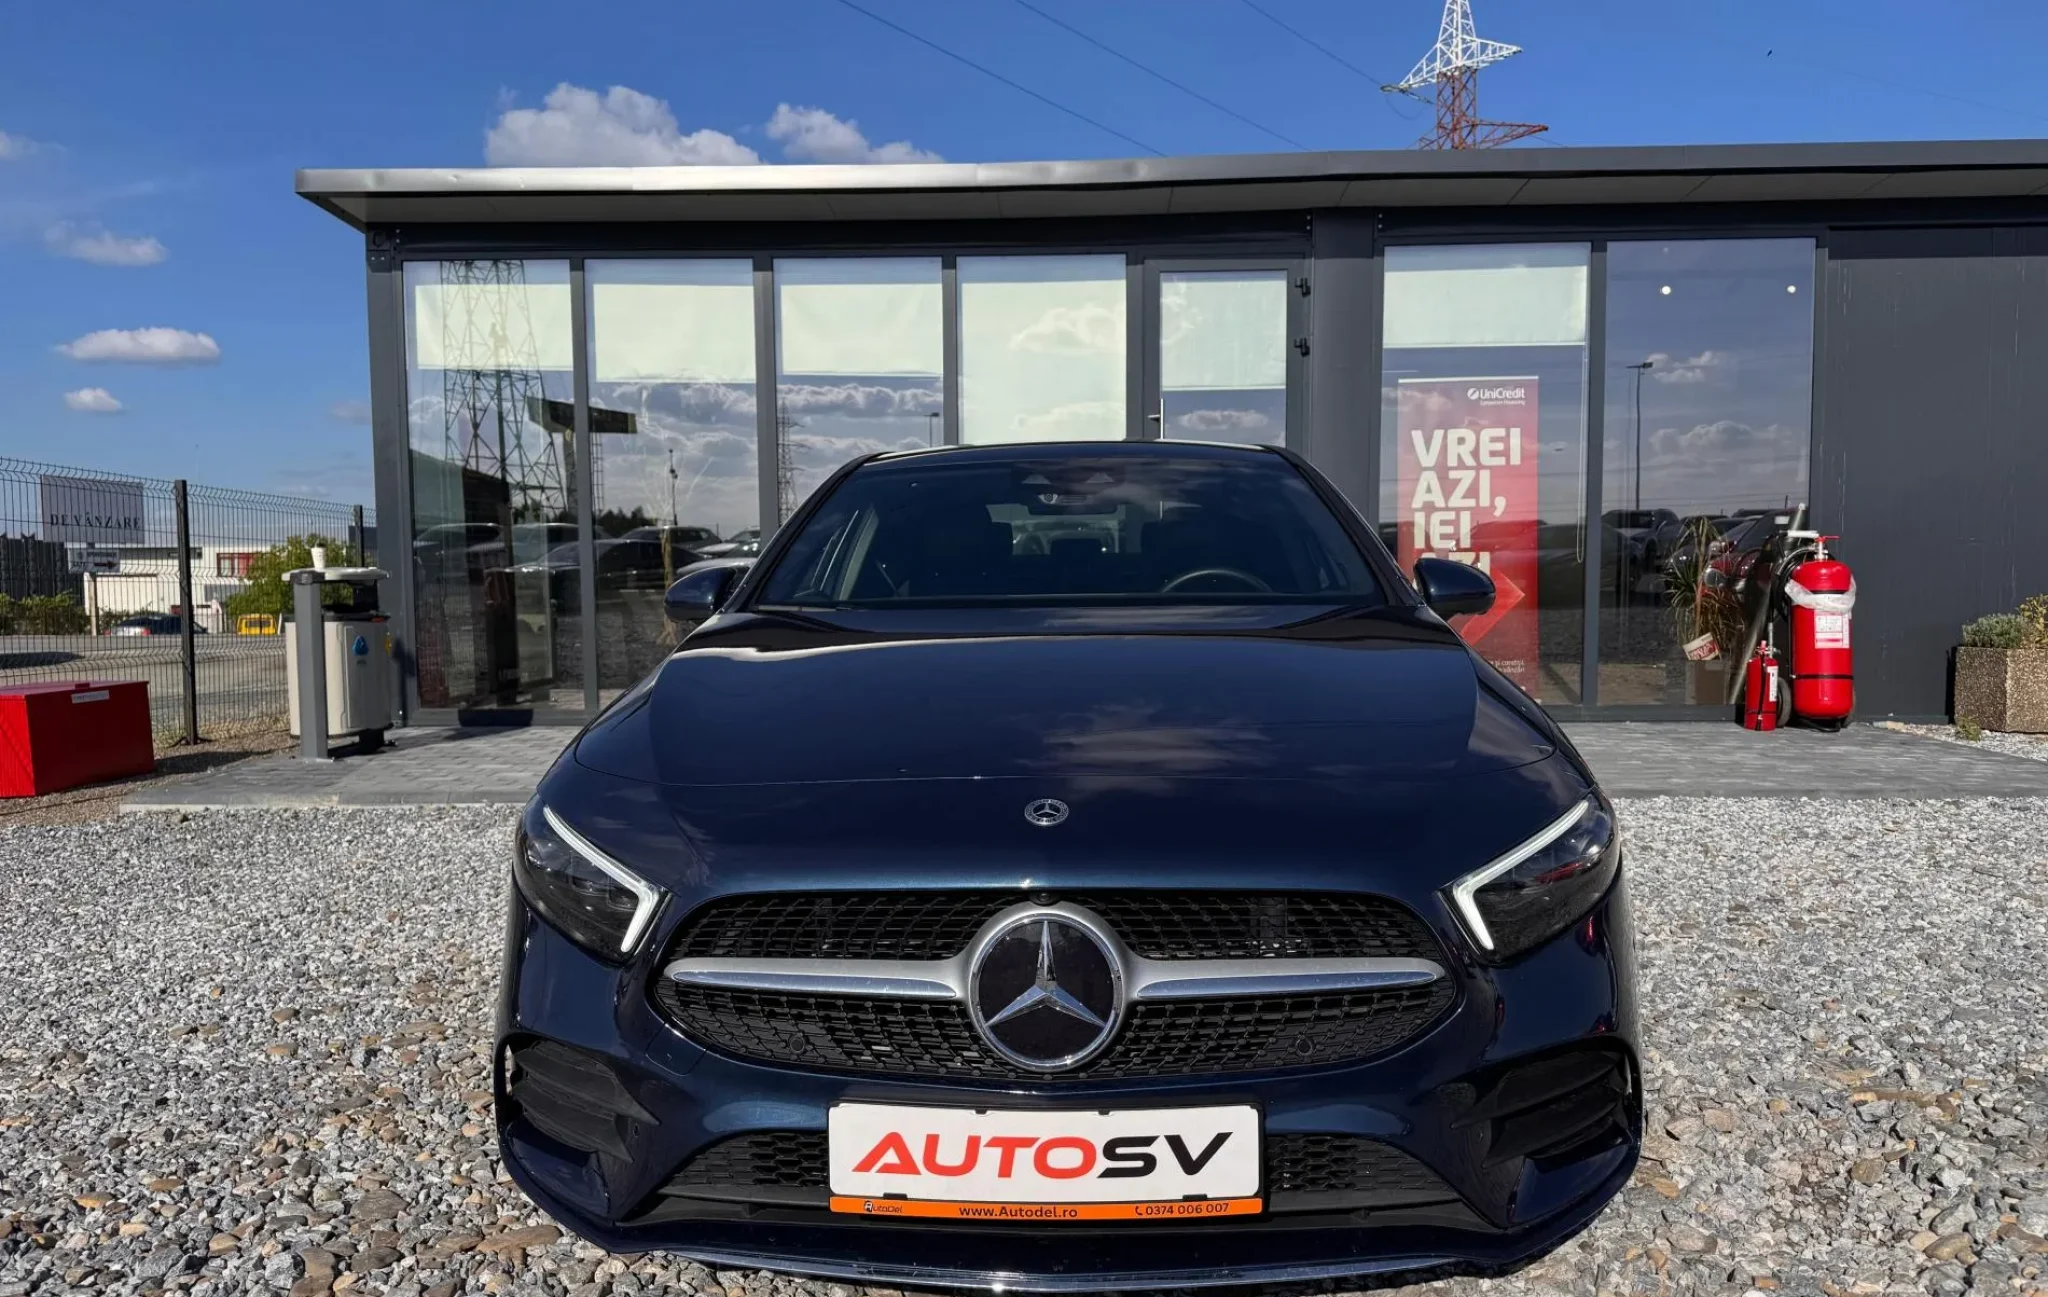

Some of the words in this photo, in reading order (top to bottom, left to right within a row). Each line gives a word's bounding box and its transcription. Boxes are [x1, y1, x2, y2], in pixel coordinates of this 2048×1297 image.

[1480, 388, 1525, 399] UniCredit
[1411, 428, 1521, 467] VREI
[1411, 469, 1507, 517] AZI,
[50, 513, 69, 527] DE
[1414, 511, 1471, 549] IEI
[851, 1131, 1233, 1179] AUTOSV
[959, 1206, 1078, 1218] www.Autodel.ro
[1145, 1205, 1174, 1215] 0374
[1177, 1204, 1203, 1214] 006
[1206, 1203, 1229, 1213] 007
